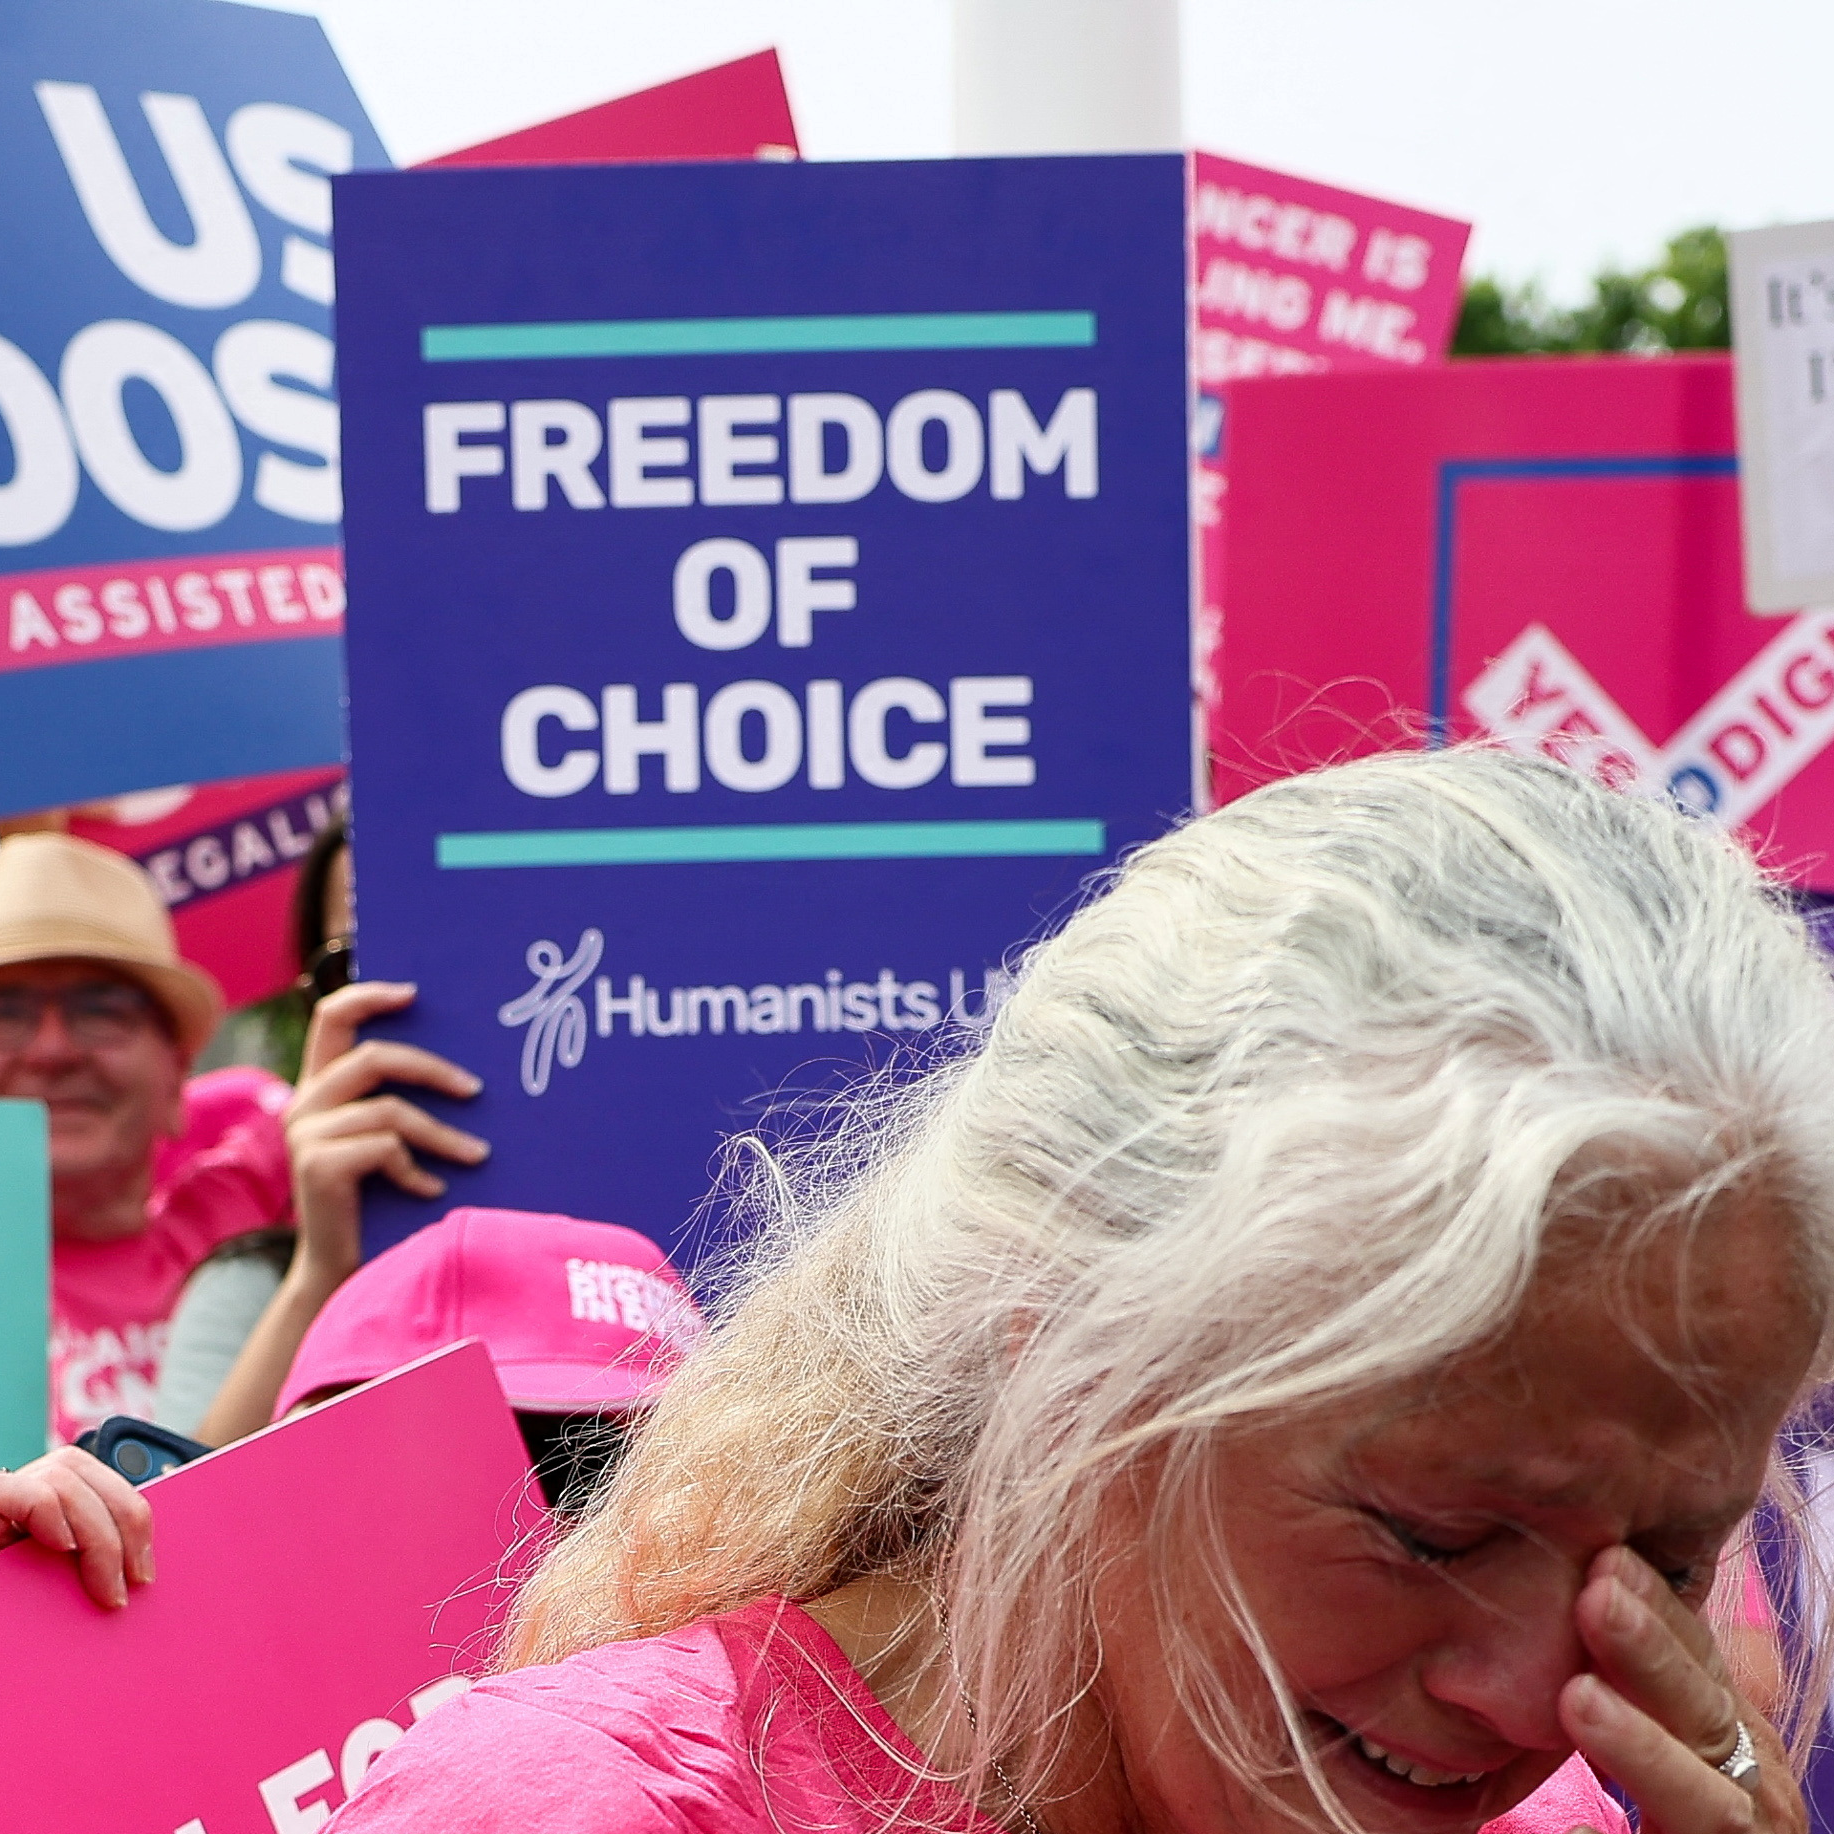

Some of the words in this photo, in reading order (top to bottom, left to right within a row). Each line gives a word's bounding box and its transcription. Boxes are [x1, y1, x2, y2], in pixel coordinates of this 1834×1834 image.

[34, 80, 355, 310] US
[1362, 225, 1433, 292] IS
[423, 387, 1098, 514] FREEDOM
[9, 562, 349, 650] ASSISTED
[671, 535, 860, 652] OF
[500, 675, 1036, 798] CHOICE
[595, 968, 941, 1039] Humanists
